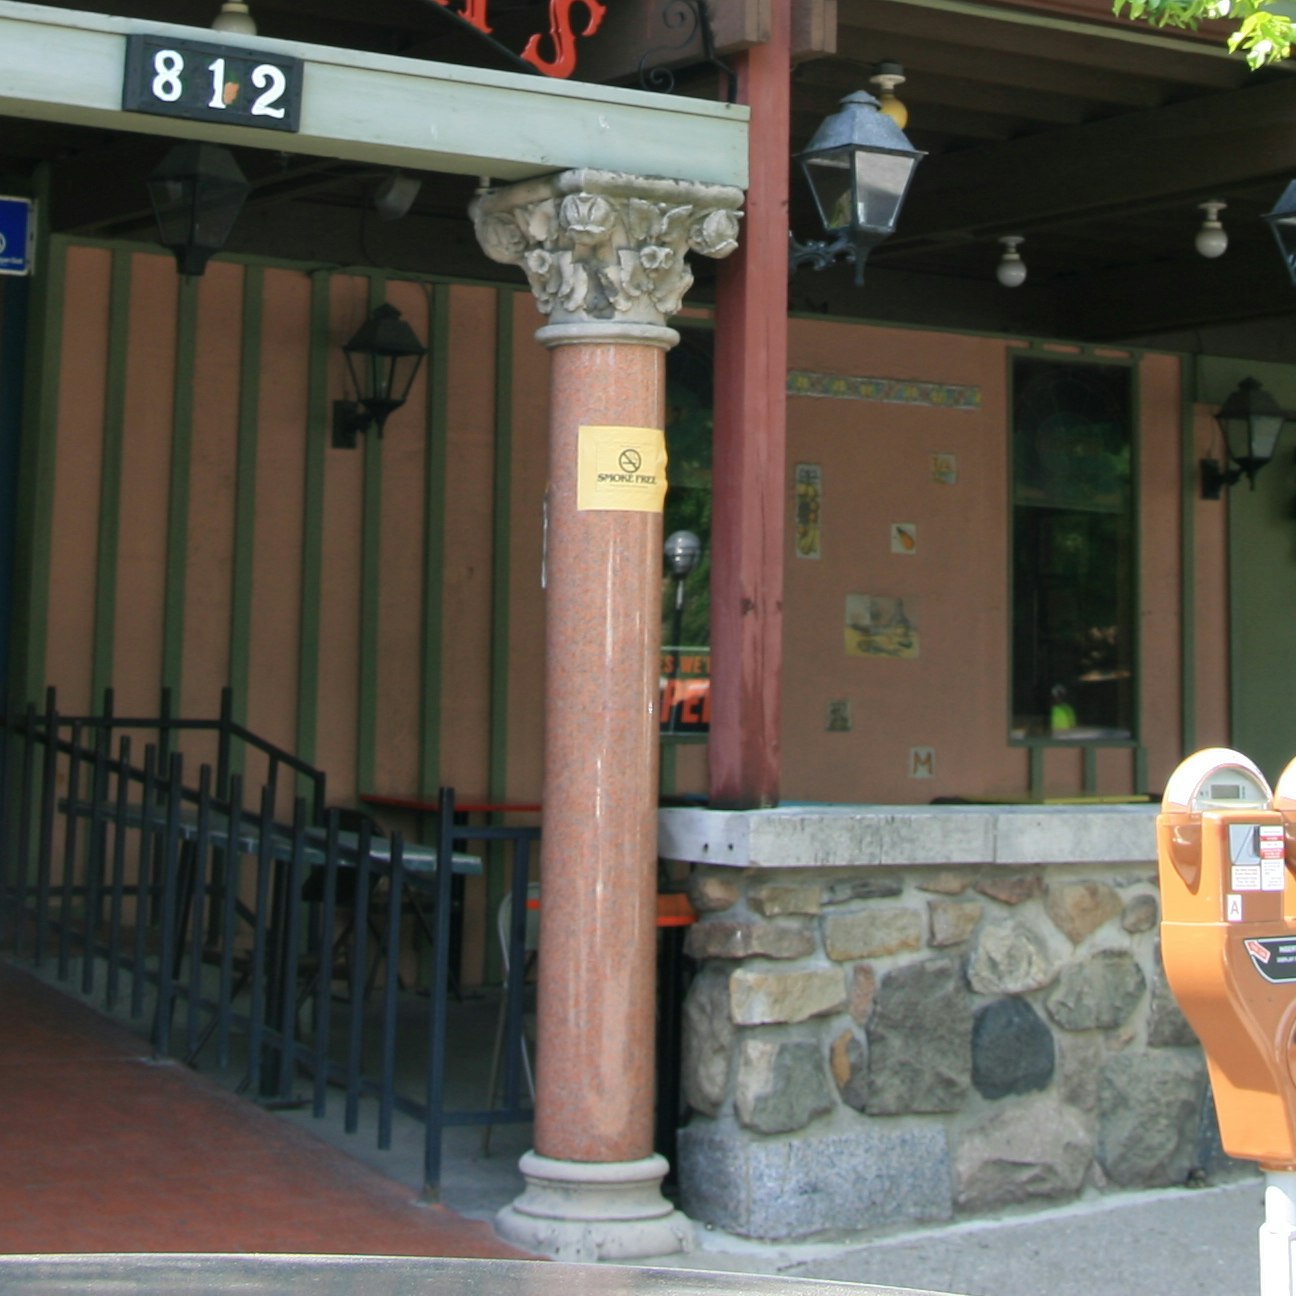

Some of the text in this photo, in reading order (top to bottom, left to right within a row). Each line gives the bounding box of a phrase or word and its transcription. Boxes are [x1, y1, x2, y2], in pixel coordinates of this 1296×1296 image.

[150, 49, 287, 120] 812
[597, 473, 657, 485] SMOKE FREE
[1230, 901, 1239, 915] A
